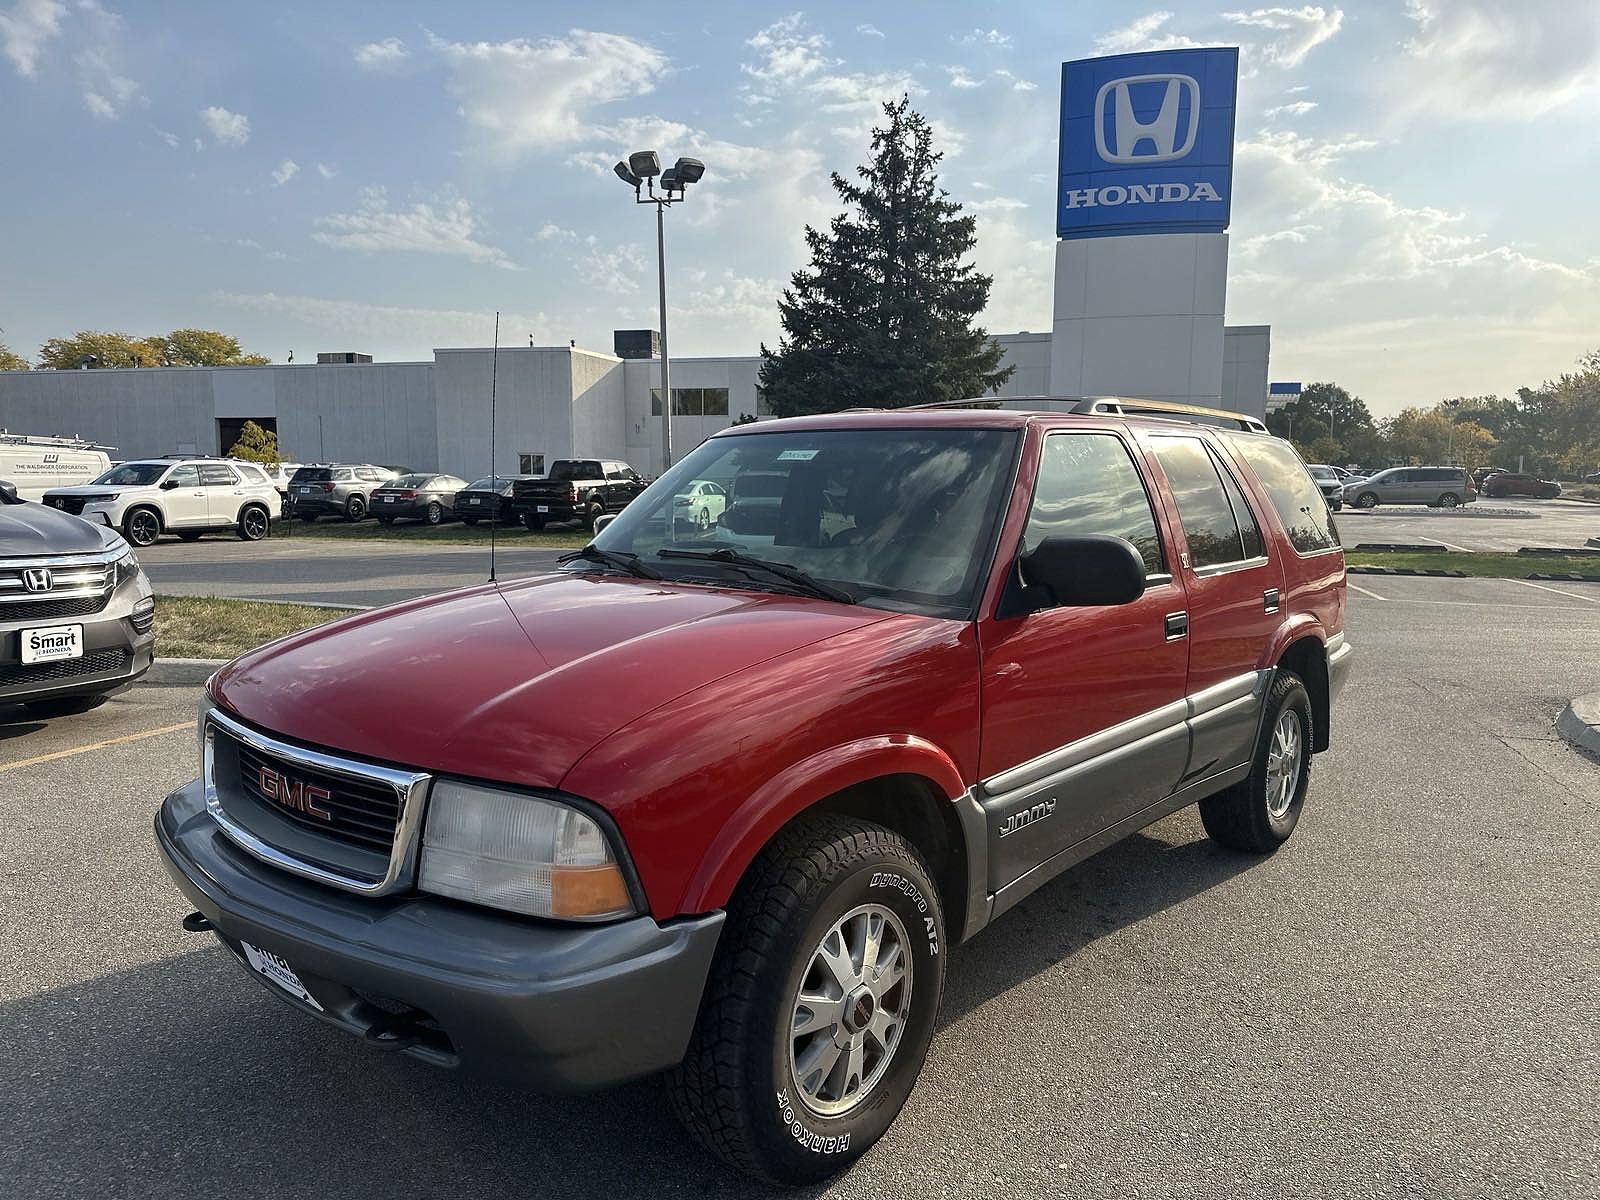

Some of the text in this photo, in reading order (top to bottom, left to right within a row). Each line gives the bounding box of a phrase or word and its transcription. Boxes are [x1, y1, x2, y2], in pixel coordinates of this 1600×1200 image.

[1065, 182, 1223, 209] HONDA
[30, 633, 76, 649] Smart
[42, 646, 72, 654] HONDA
[259, 766, 331, 821] GMC
[923, 916, 939, 956] AT2
